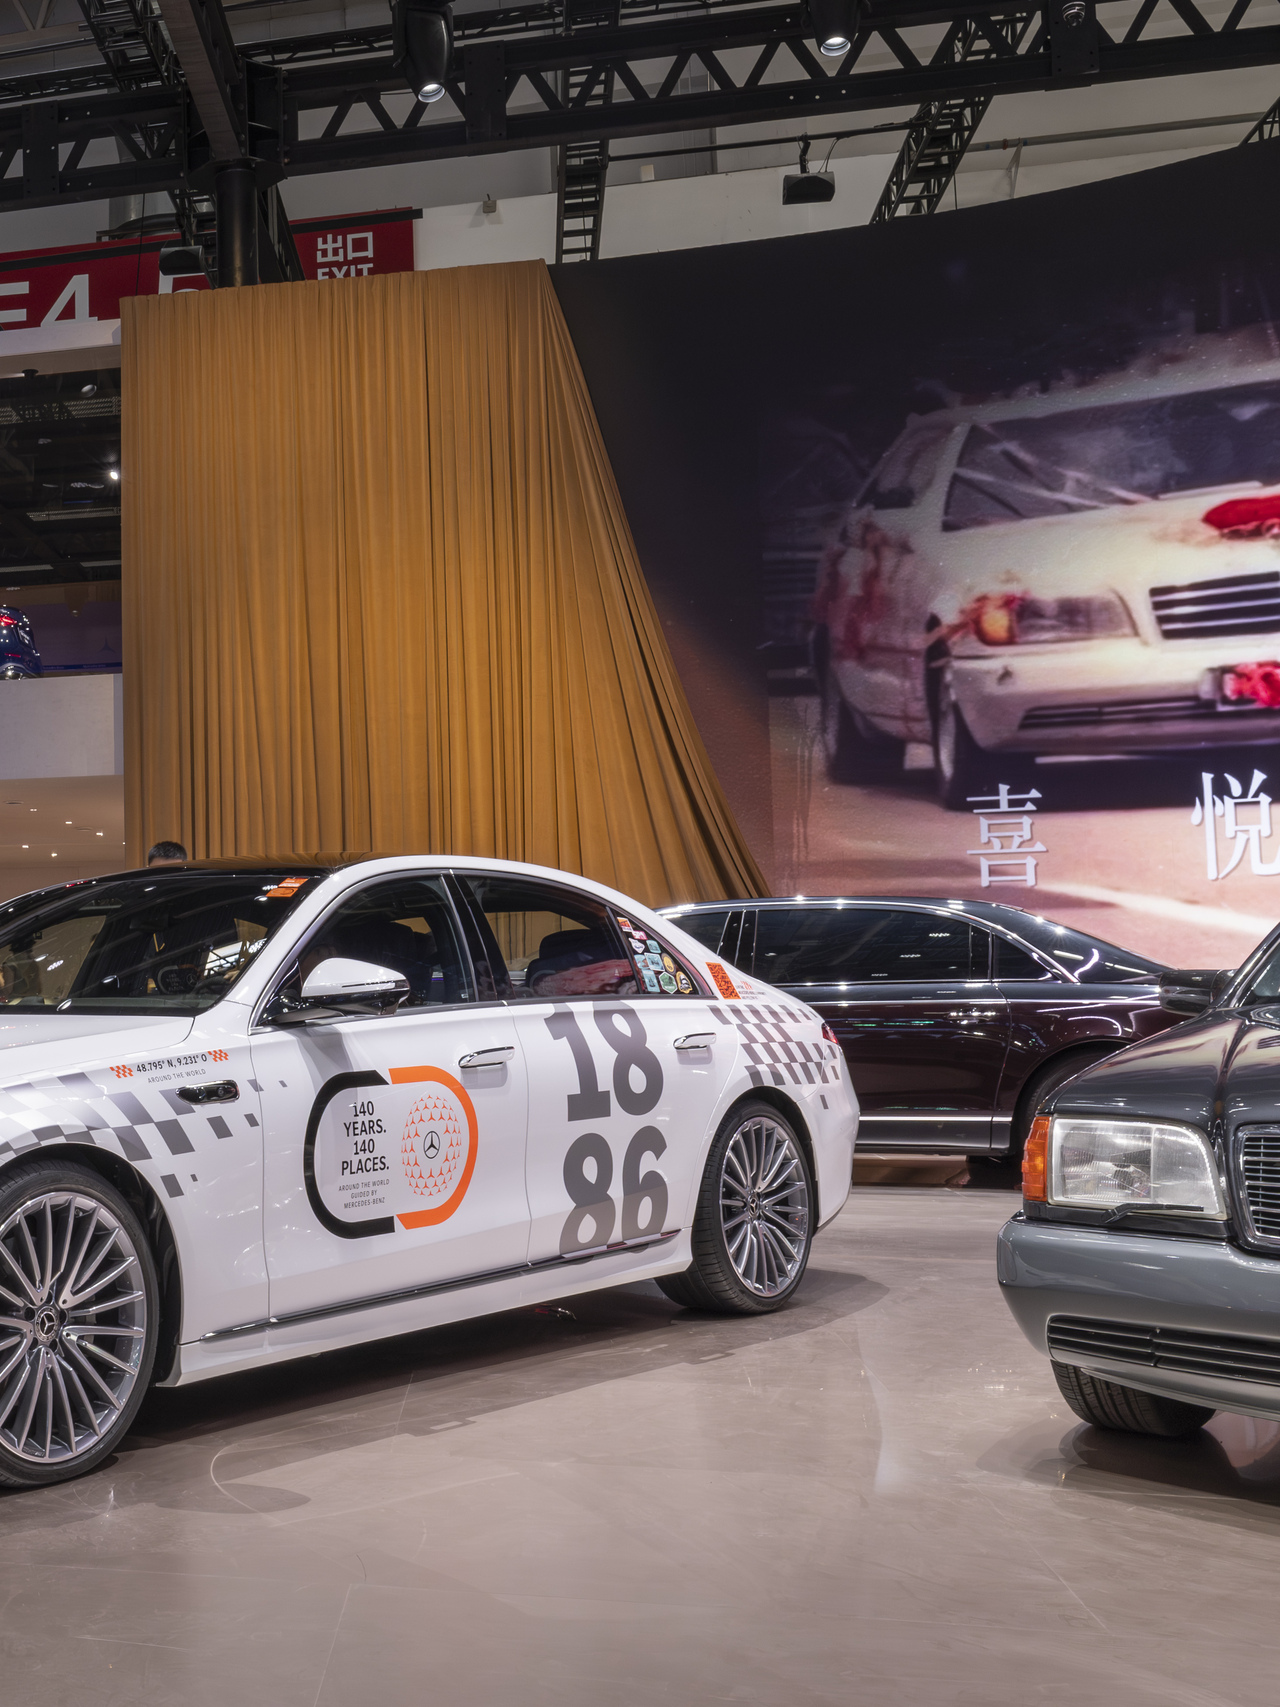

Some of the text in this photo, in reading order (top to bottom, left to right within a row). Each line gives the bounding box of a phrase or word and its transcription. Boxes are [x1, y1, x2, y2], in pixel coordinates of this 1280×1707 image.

[316, 231, 374, 263] 出口
[317, 263, 374, 281] EXIT
[543, 1000, 664, 1122] 18
[147, 1068, 207, 1083] AROUND THE WORLD
[353, 1100, 375, 1118] 140
[343, 1118, 387, 1138] YEARS.
[353, 1138, 375, 1156] 140
[341, 1155, 390, 1176] PLACES.
[338, 1183, 360, 1192] AROUND
[371, 1178, 390, 1188] WORLD
[343, 1197, 386, 1209] MERCEDES-BENZ
[350, 1189, 378, 1200] GUIDED BY
[558, 1125, 669, 1265] 86
